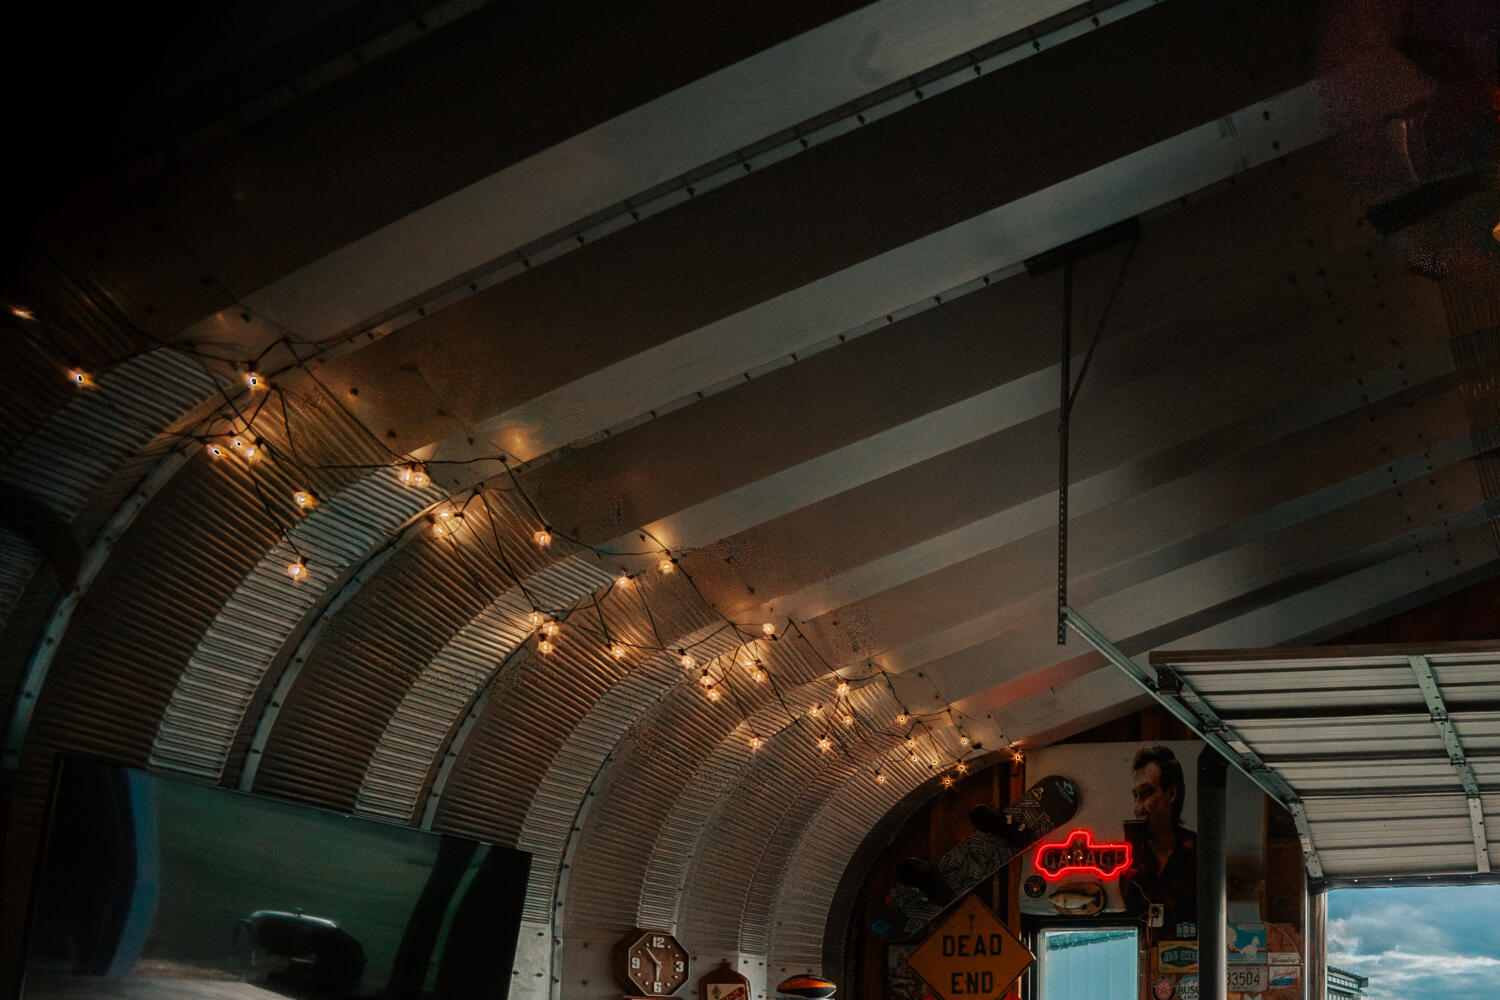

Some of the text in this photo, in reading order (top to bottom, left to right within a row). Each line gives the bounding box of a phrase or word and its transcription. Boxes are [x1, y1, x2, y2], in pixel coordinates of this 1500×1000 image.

[652, 936, 665, 948] 12
[942, 934, 1003, 957] DEAD
[1180, 950, 1198, 961] DEER
[631, 957, 641, 969] 9
[675, 961, 684, 972] 3
[653, 981, 662, 993] 6
[951, 971, 994, 994] END
